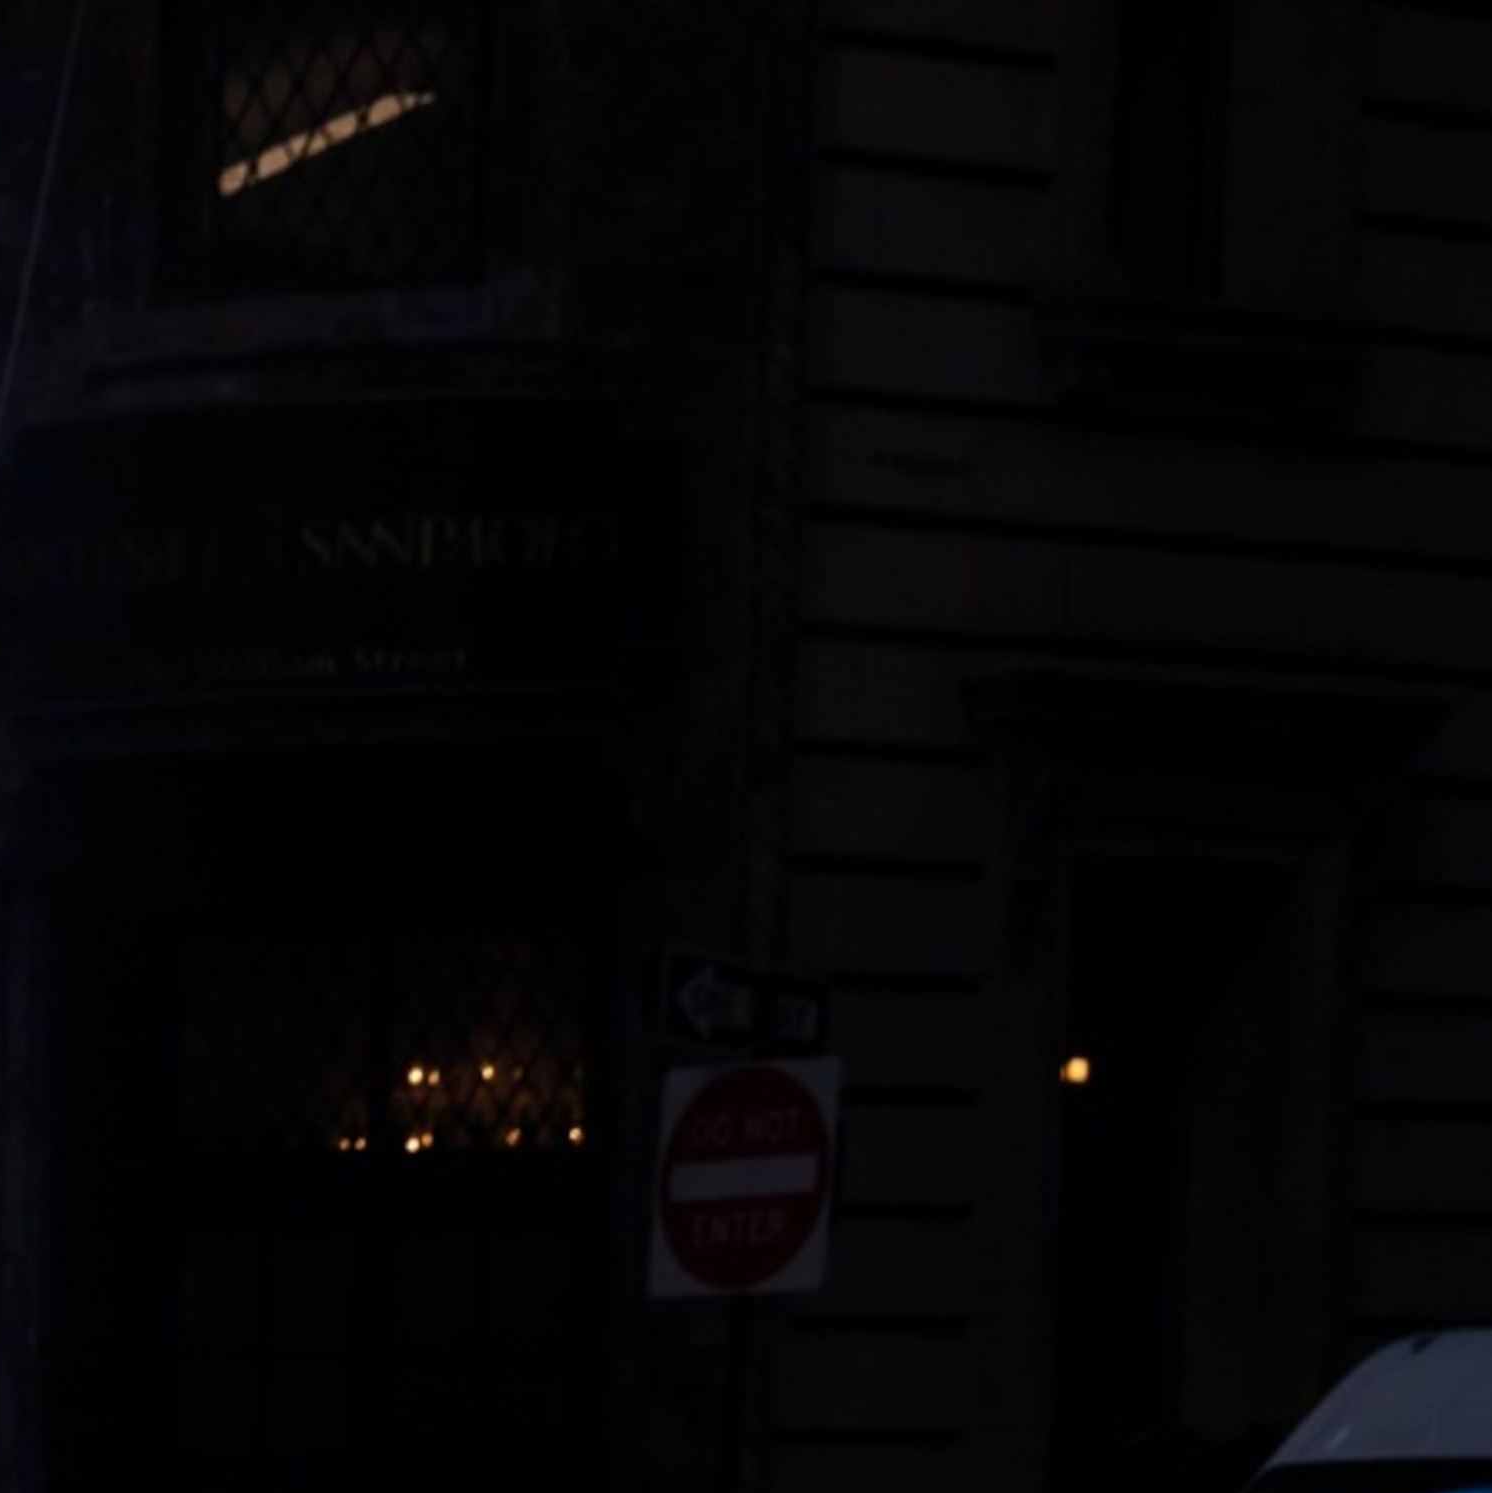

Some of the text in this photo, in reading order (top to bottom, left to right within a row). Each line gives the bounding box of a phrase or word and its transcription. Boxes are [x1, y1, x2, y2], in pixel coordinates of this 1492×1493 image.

[353, 645, 473, 675] Street
[691, 1103, 801, 1149] DO NOT
[690, 1206, 788, 1248] ENTER
